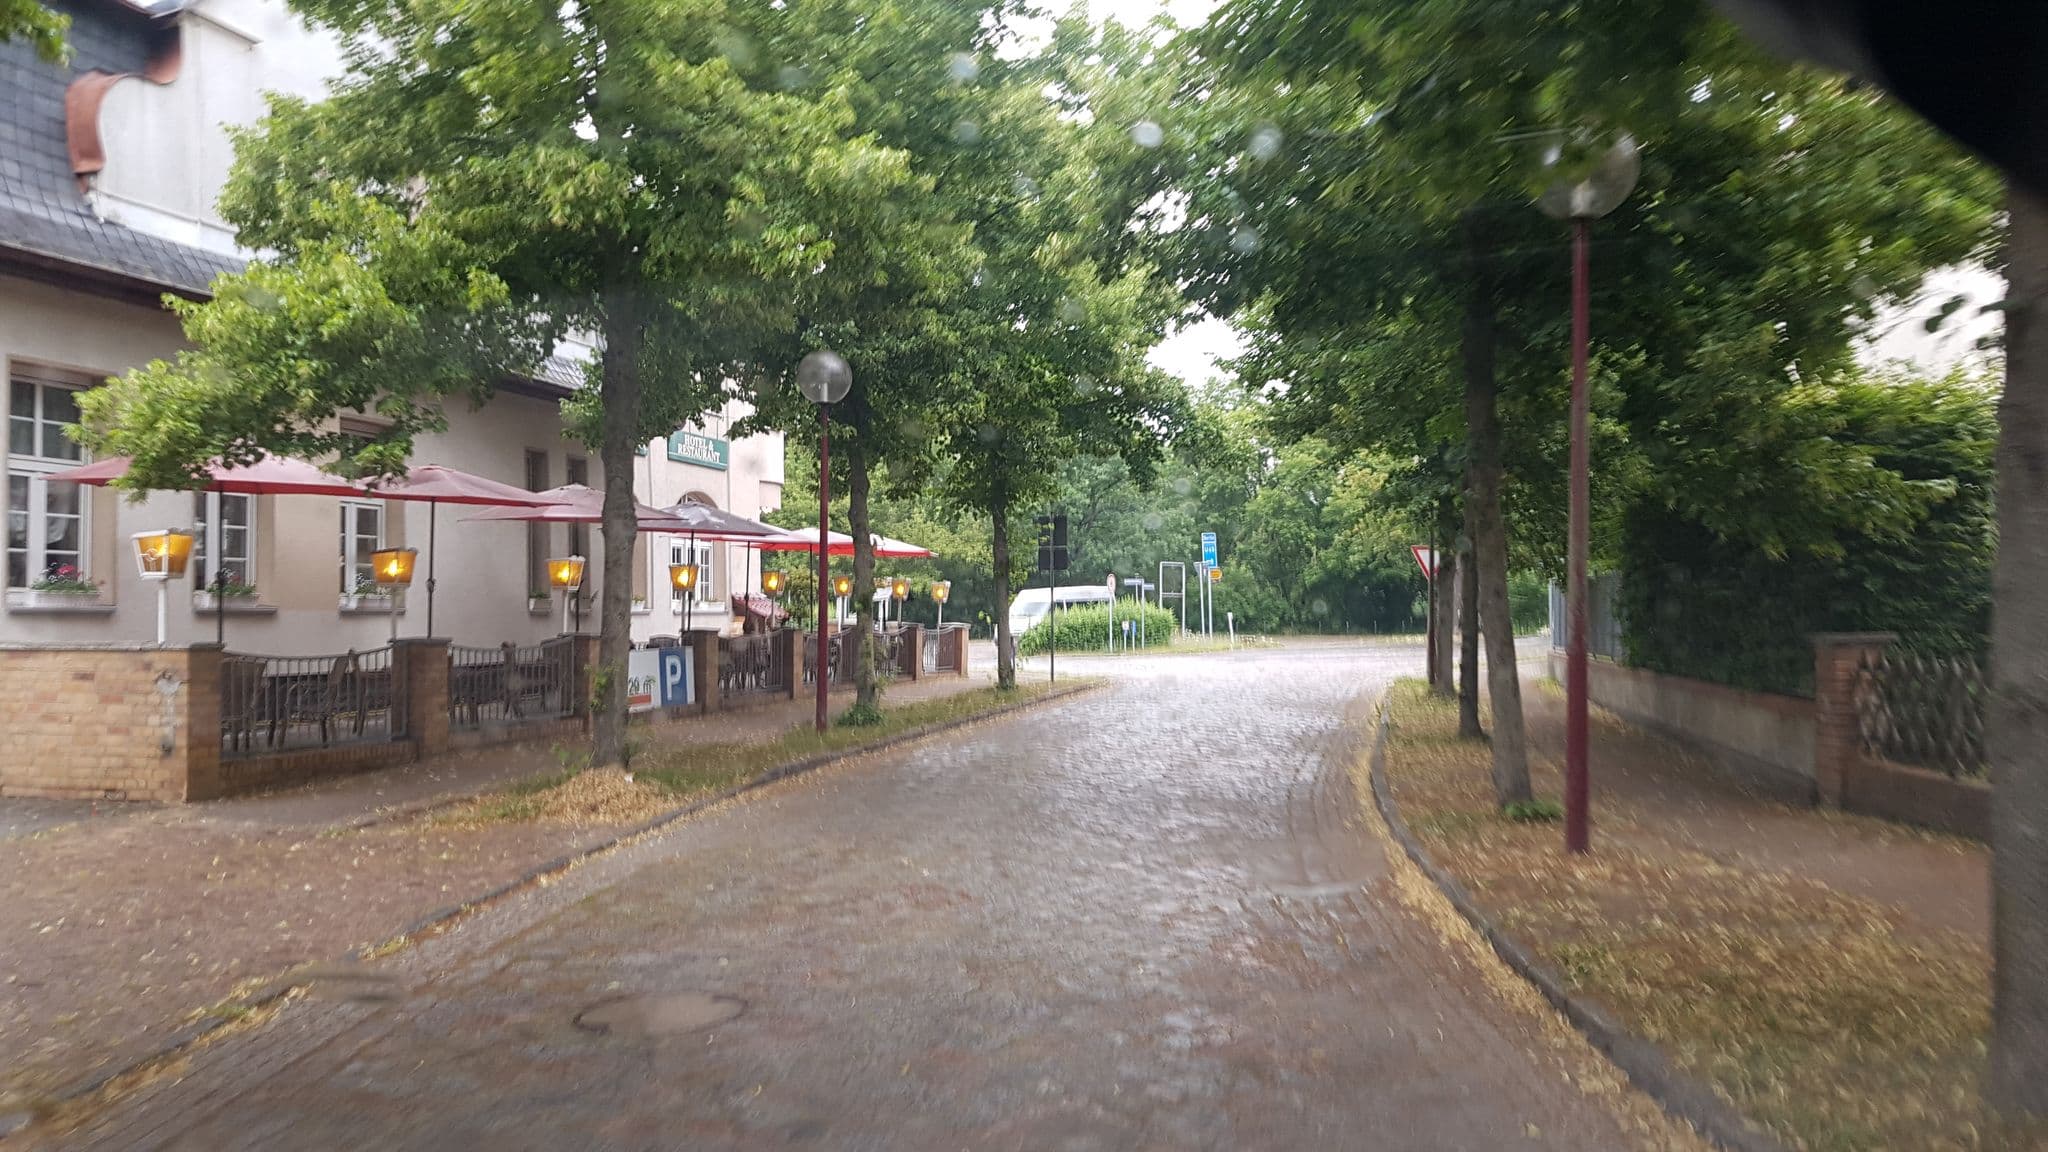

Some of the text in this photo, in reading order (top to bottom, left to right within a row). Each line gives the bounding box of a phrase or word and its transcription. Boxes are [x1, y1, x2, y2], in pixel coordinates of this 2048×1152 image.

[684, 434, 714, 451] HOTEL &
[677, 443, 721, 463] RESTAURANT
[665, 655, 682, 701] P
